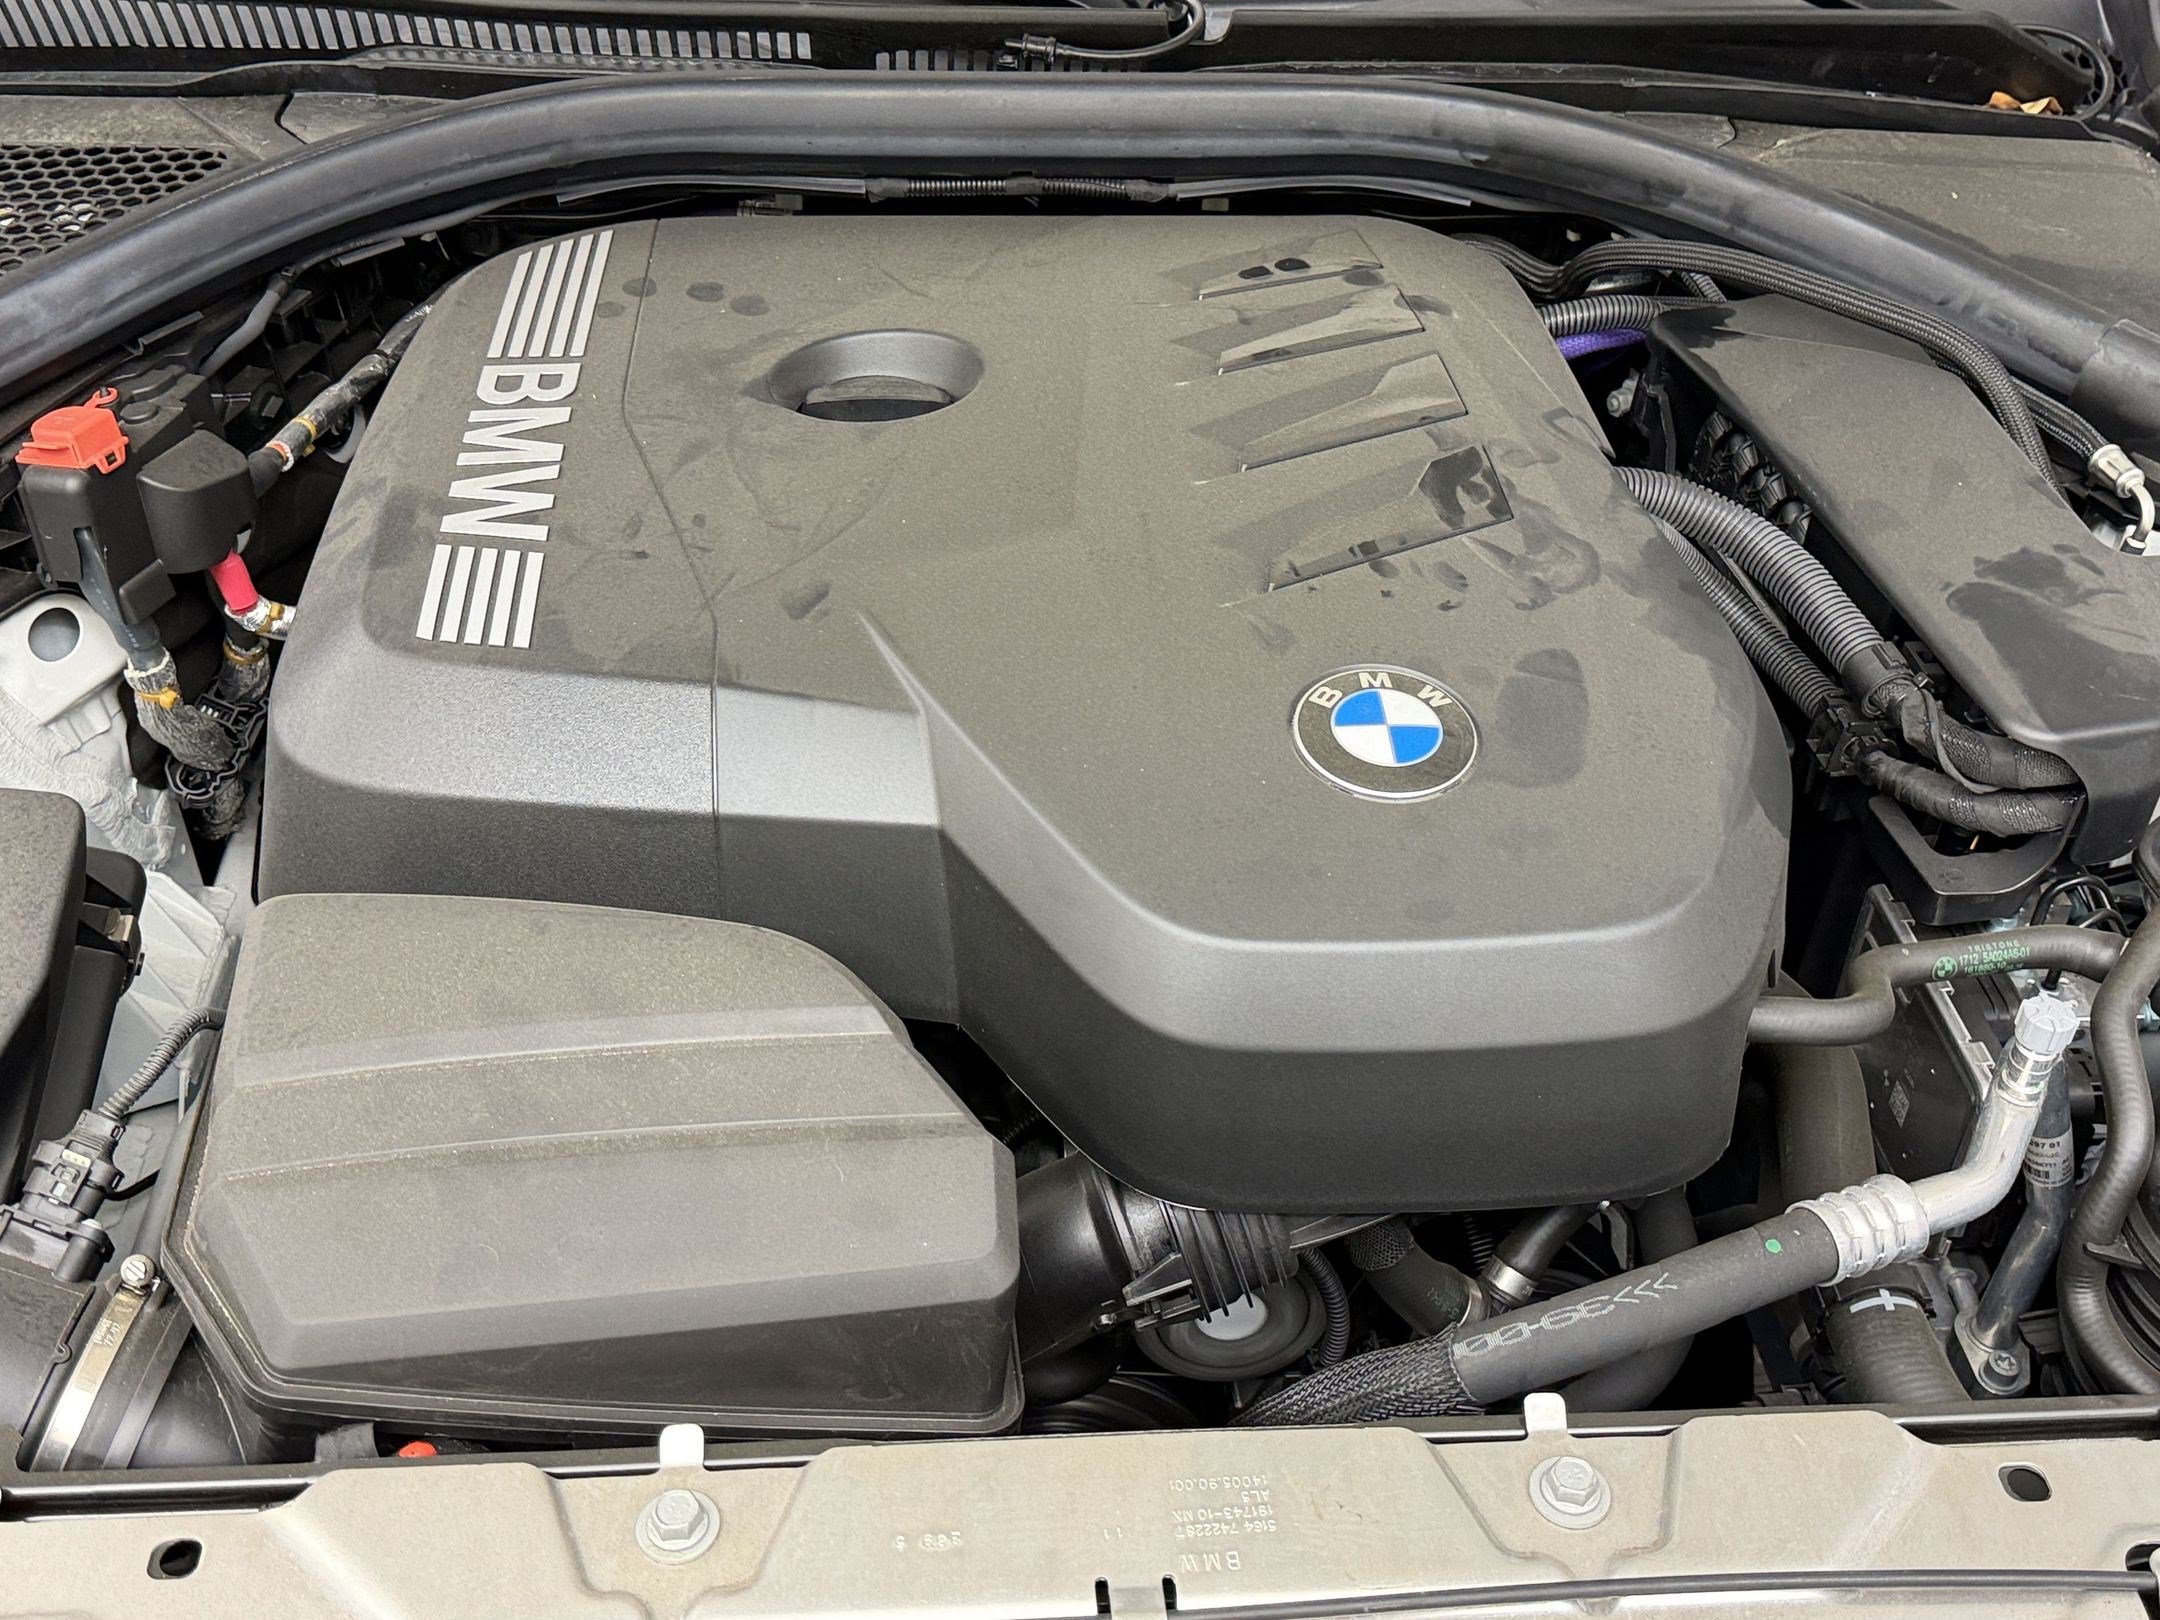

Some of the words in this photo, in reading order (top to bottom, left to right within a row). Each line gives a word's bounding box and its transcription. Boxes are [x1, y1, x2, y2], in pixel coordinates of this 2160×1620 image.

[440, 363, 582, 541] BMW
[1308, 672, 1453, 709] BMW
[1968, 940, 2019, 953] TRISTONE
[1959, 953, 1979, 966] 1712
[1243, 1519, 1276, 1533] 5164
[1180, 1550, 1241, 1573] BMW
